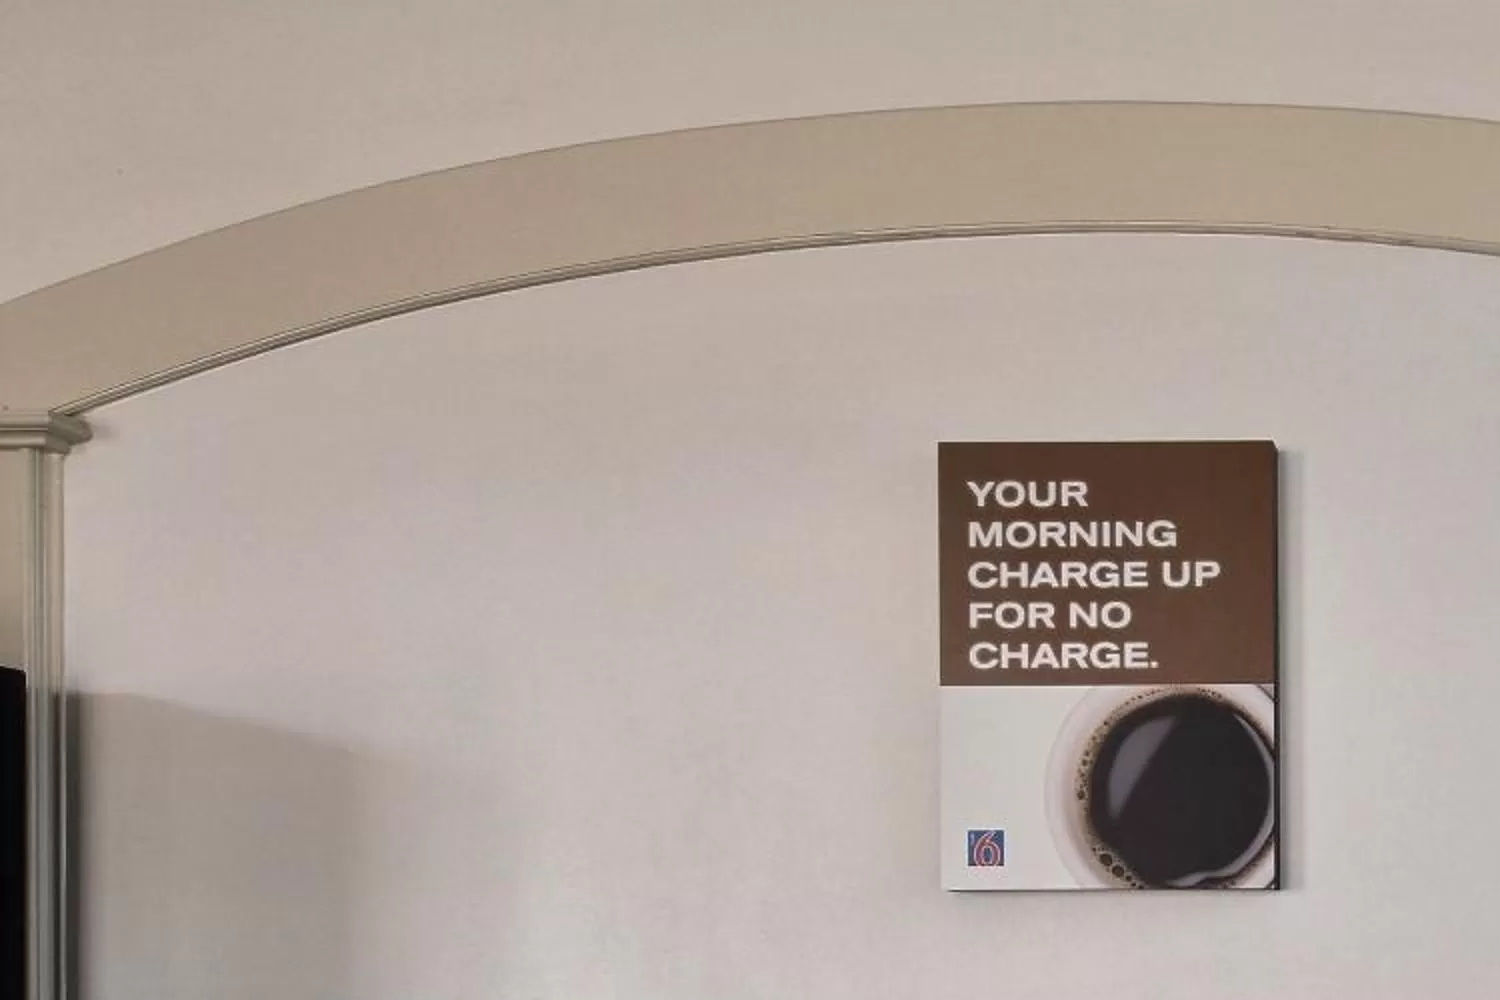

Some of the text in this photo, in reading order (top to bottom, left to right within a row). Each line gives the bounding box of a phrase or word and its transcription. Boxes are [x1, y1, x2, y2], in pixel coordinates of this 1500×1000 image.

[967, 480, 1089, 508] YOUR
[968, 520, 1177, 549] MORNING
[968, 560, 1221, 589] CHARGE UP
[968, 600, 1132, 629] FOR NO
[968, 641, 1159, 670] CHARGE.
[974, 832, 1000, 866] 6
